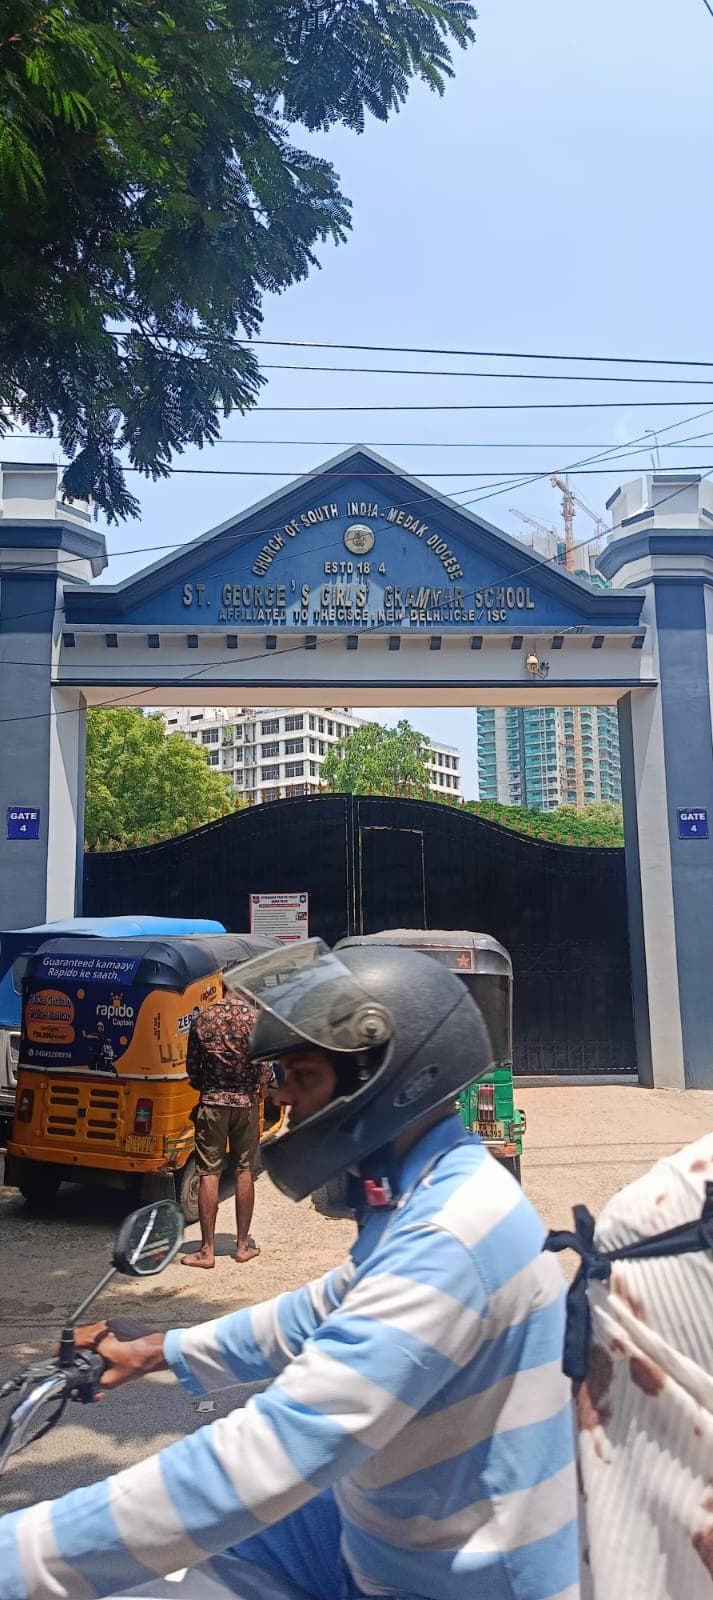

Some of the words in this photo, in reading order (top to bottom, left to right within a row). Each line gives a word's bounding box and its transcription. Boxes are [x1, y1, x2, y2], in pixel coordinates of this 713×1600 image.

[252, 533, 286, 576] CHURCH
[285, 519, 301, 537] OF
[301, 503, 339, 527] SOUTH
[426, 534, 464, 580] DIOCESE
[324, 561, 353, 574] ESTD
[183, 583, 211, 607] ST.
[475, 586, 535, 609] SCHOOL
[219, 608, 286, 621] AFFILIATED
[294, 609, 309, 621] TO
[378, 609, 403, 621] NEW
[10, 812, 38, 820] GATE
[680, 813, 706, 821] GATE
[19, 824, 27, 832] 4
[690, 824, 697, 832] 4
[43, 957, 94, 968] Guaranteed
[96, 959, 134, 973] kamaayi
[48, 967, 78, 979] Rapido
[80, 969, 91, 978] ke
[96, 1004, 134, 1019] rapido
[112, 1018, 134, 1026] Captain
